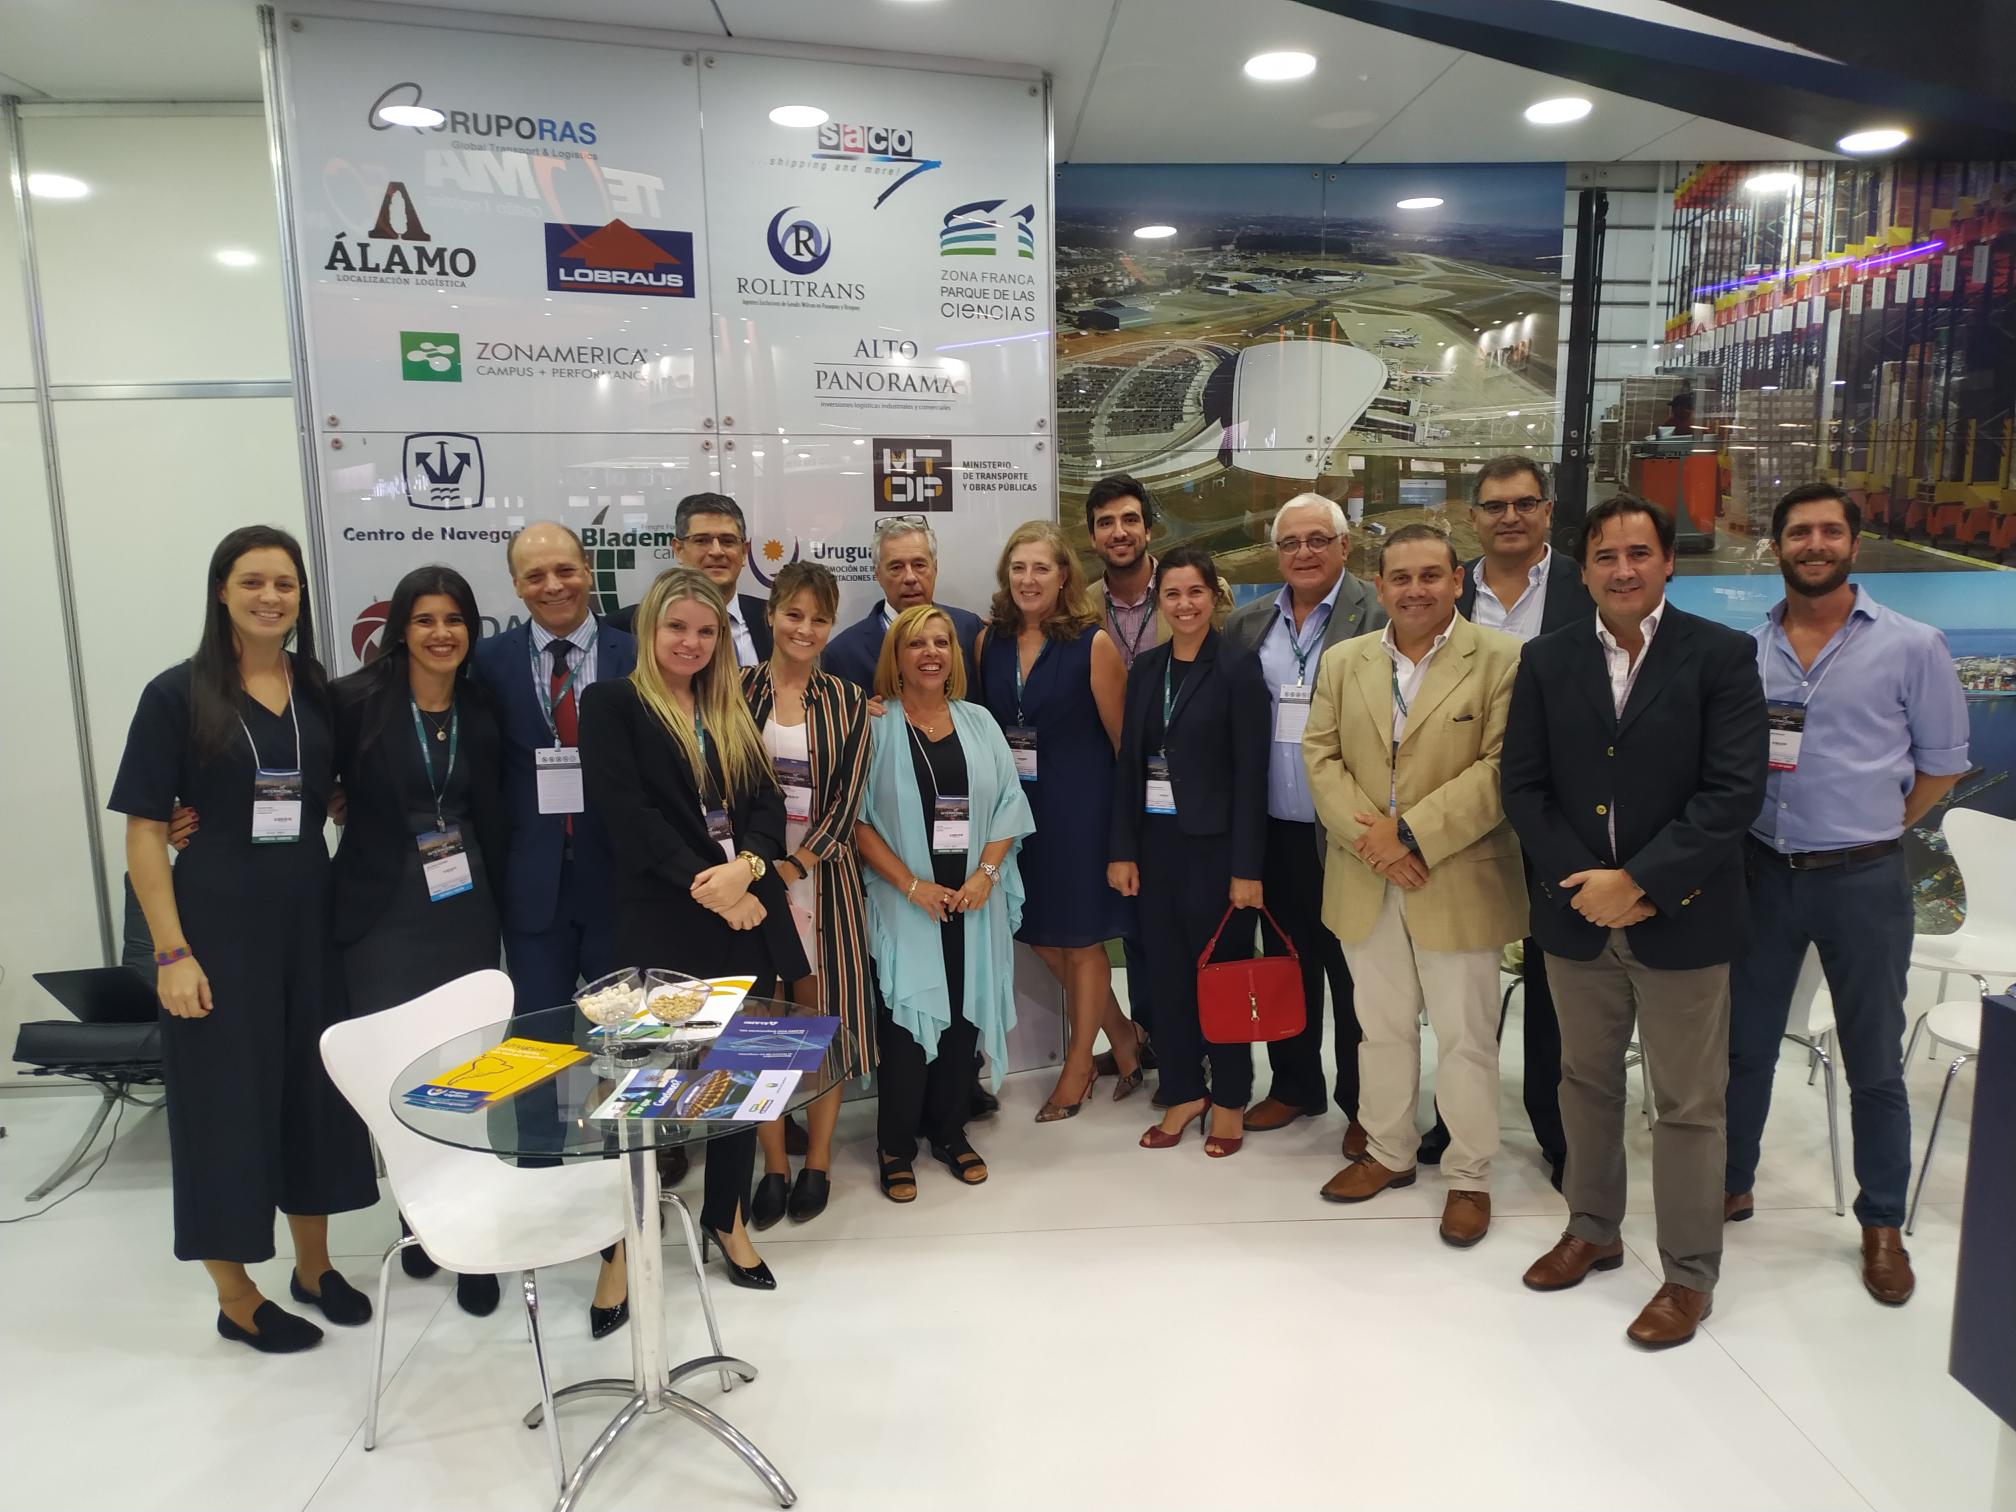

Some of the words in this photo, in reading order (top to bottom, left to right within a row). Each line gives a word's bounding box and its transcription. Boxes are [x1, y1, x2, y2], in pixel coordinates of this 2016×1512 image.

[819, 124, 912, 154] saco
[451, 139, 487, 152] Global
[489, 143, 540, 157] Transport
[543, 148, 549, 157] &
[834, 162, 858, 173] and
[864, 166, 902, 177] more!
[324, 231, 477, 279] ÁLAMO
[336, 274, 411, 286] LOCALIZACIÓN
[415, 277, 467, 288] LOGÍSTICA
[559, 267, 684, 288] LOBRAUS
[940, 269, 979, 282] ZONA
[981, 272, 1035, 286] FRANCA
[737, 276, 866, 301] ROLITRANS
[940, 286, 990, 299] PARQUE
[993, 289, 1010, 301] DE
[1012, 290, 1035, 302] LAS
[476, 341, 648, 366] ZONAMERICA
[853, 338, 919, 361] ALTO
[476, 365, 535, 378] CAMPUS
[539, 368, 546, 376] +
[814, 369, 958, 395] PANORAMA
[962, 460, 1011, 470] MINISTERIO
[962, 472, 974, 481] DE
[976, 472, 1029, 481] TRANSPORTE
[969, 483, 995, 492] OBRAS
[998, 481, 1038, 492] PÚBLICAS
[343, 526, 405, 542] Centro
[412, 527, 433, 542] de
[860, 565, 870, 573] DE
